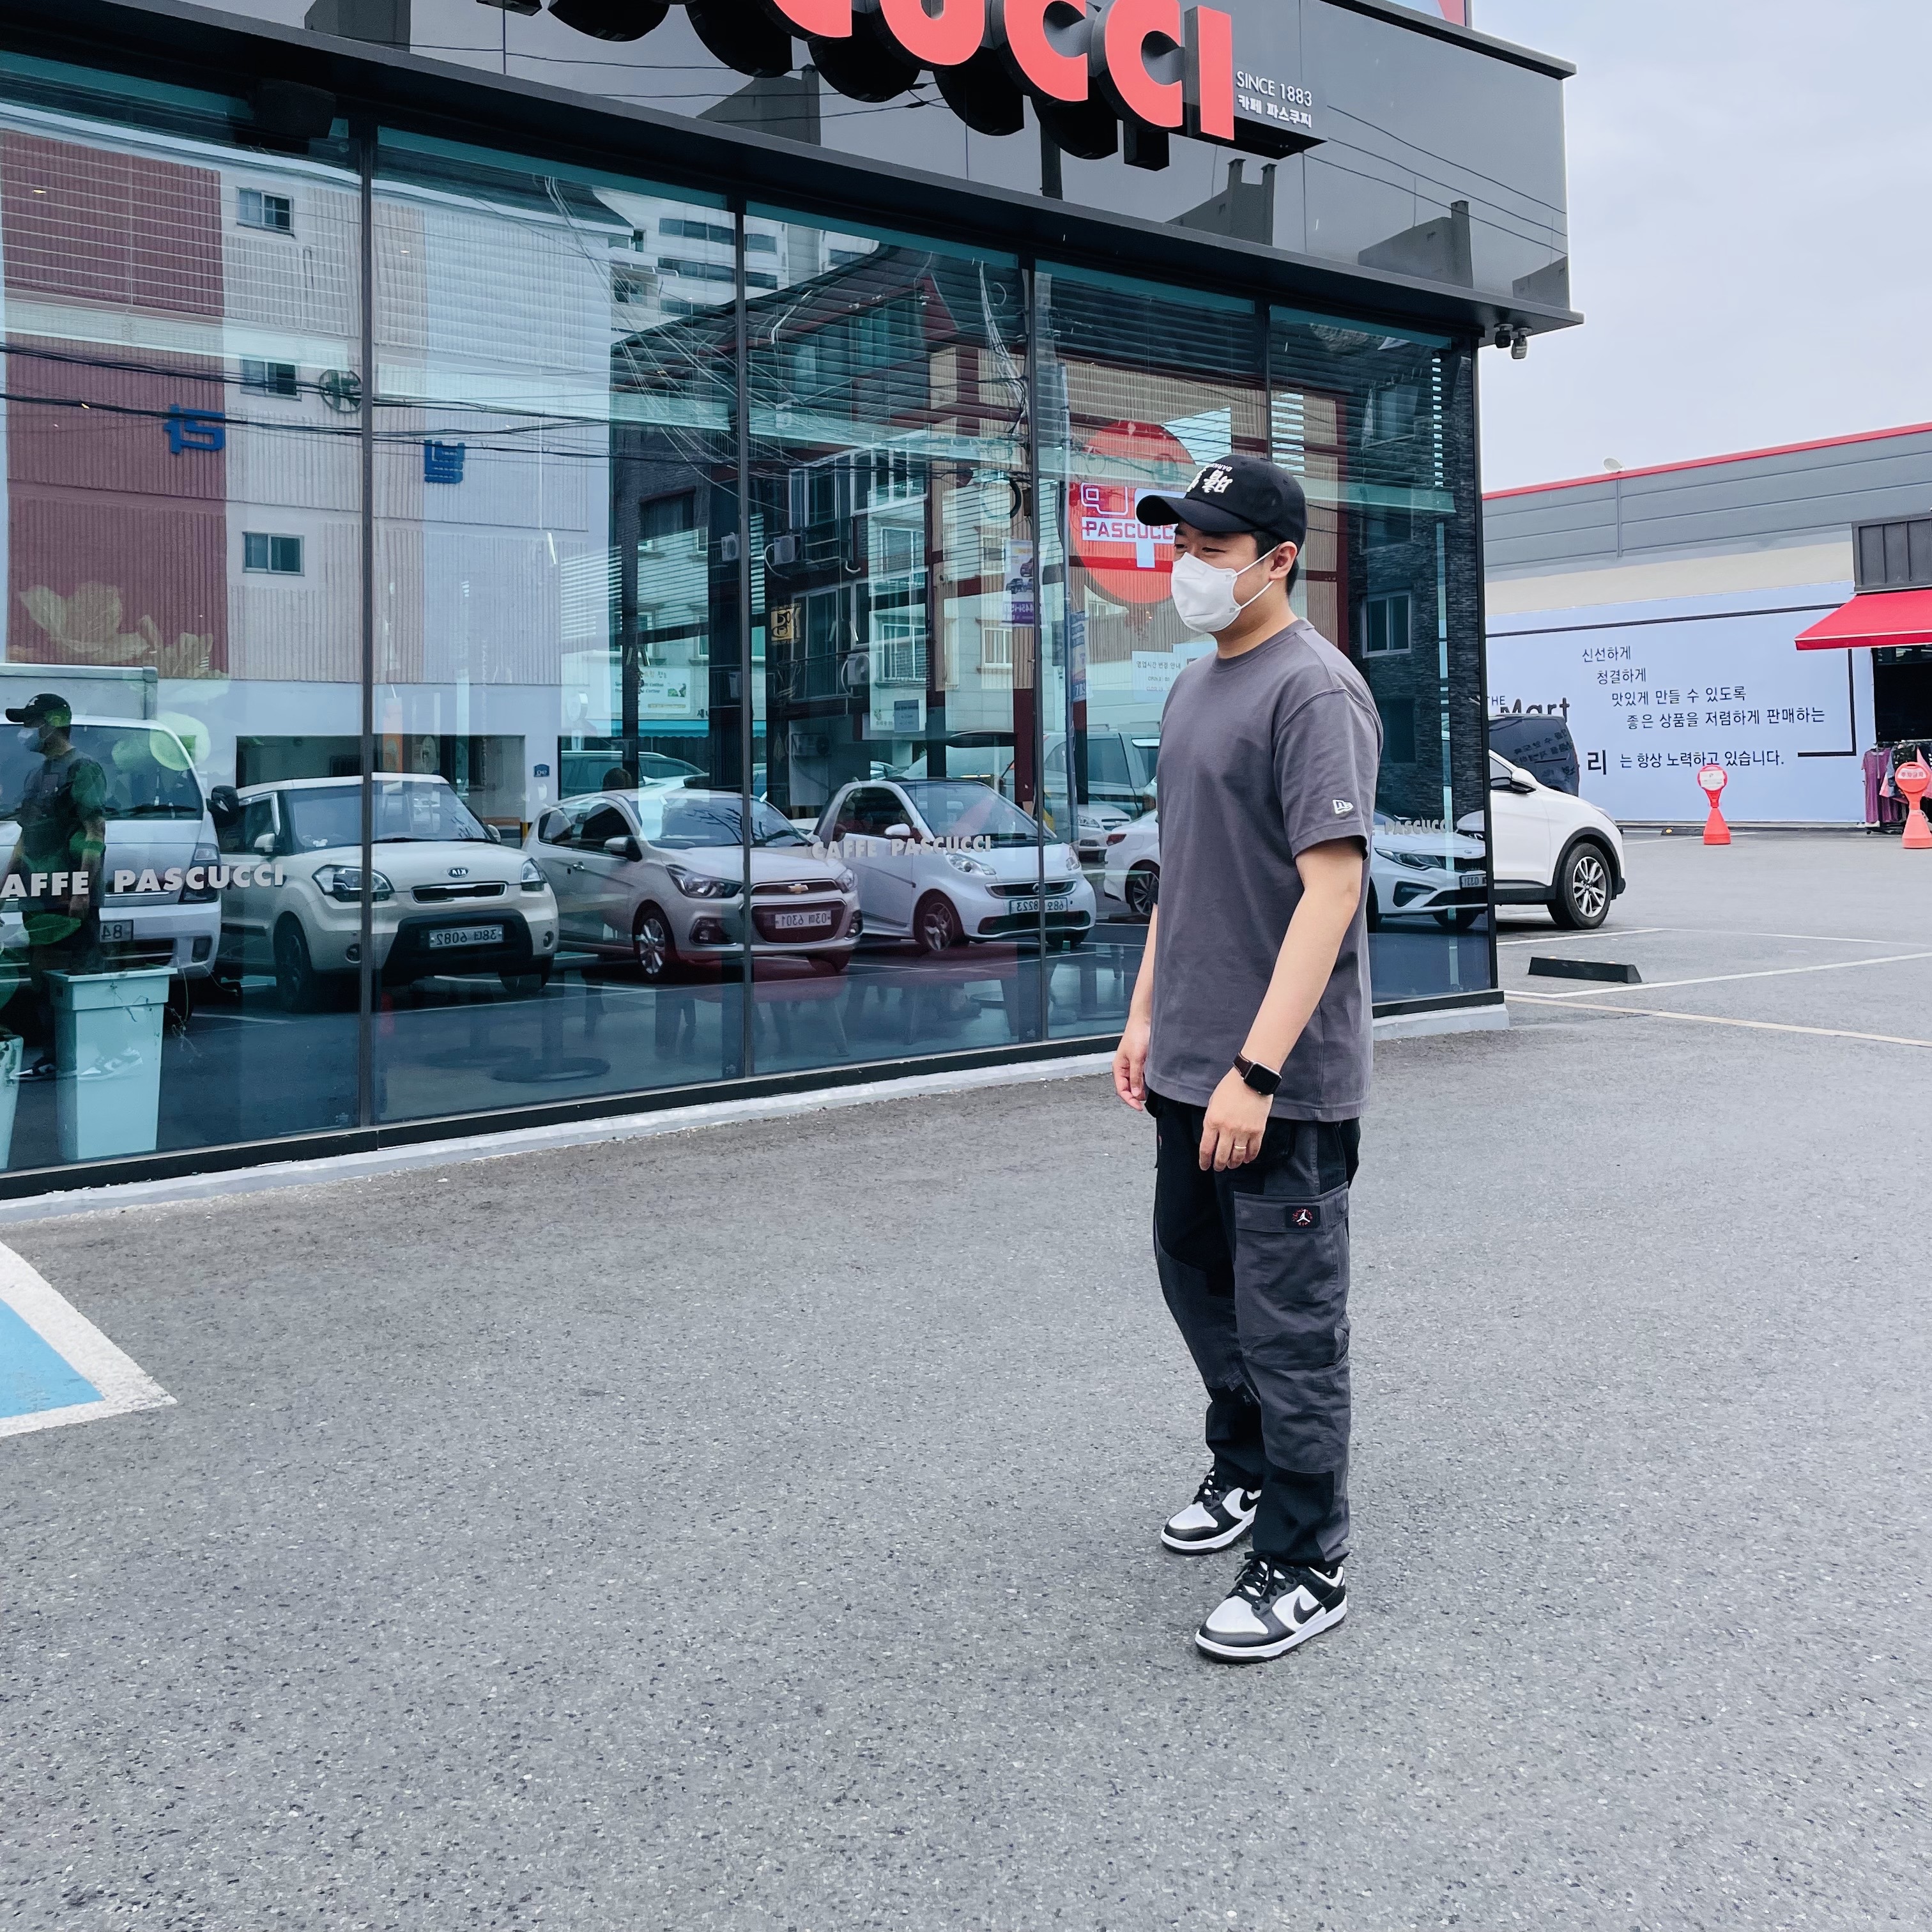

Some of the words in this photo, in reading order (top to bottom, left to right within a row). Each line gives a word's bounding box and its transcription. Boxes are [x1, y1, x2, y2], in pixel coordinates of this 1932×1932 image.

[1236, 71, 1275, 96] SINCE
[1280, 83, 1312, 107] 1883
[1238, 95, 1262, 114] 카페
[1085, 520, 1174, 540] PASCUCC
[1582, 645, 1631, 663] 신선하게
[1137, 661, 1156, 669] 영업시간
[1597, 668, 1646, 685] 청결하게
[1612, 691, 1649, 707] 맛있게
[1655, 690, 1681, 704] 만들
[1687, 689, 1699, 703] 수
[1705, 686, 1747, 702] 있도록
[1627, 714, 1654, 730] 좋은
[1659, 712, 1699, 728] 상품을
[1705, 709, 1759, 726] 저렴하게
[1767, 707, 1825, 724] 판매하는
[1587, 749, 1607, 776] 리
[1620, 753, 1633, 769] 는
[1637, 753, 1662, 769] 항상
[1666, 751, 1720, 767] 노력하고
[1724, 749, 1784, 767] 있습니다.
[1384, 819, 1452, 835] PASCUCCI
[811, 839, 877, 859] CAFFE
[891, 835, 990, 857] PASCUCCI
[0, 871, 89, 898] AFFE
[114, 864, 284, 893] PASCUCCI
